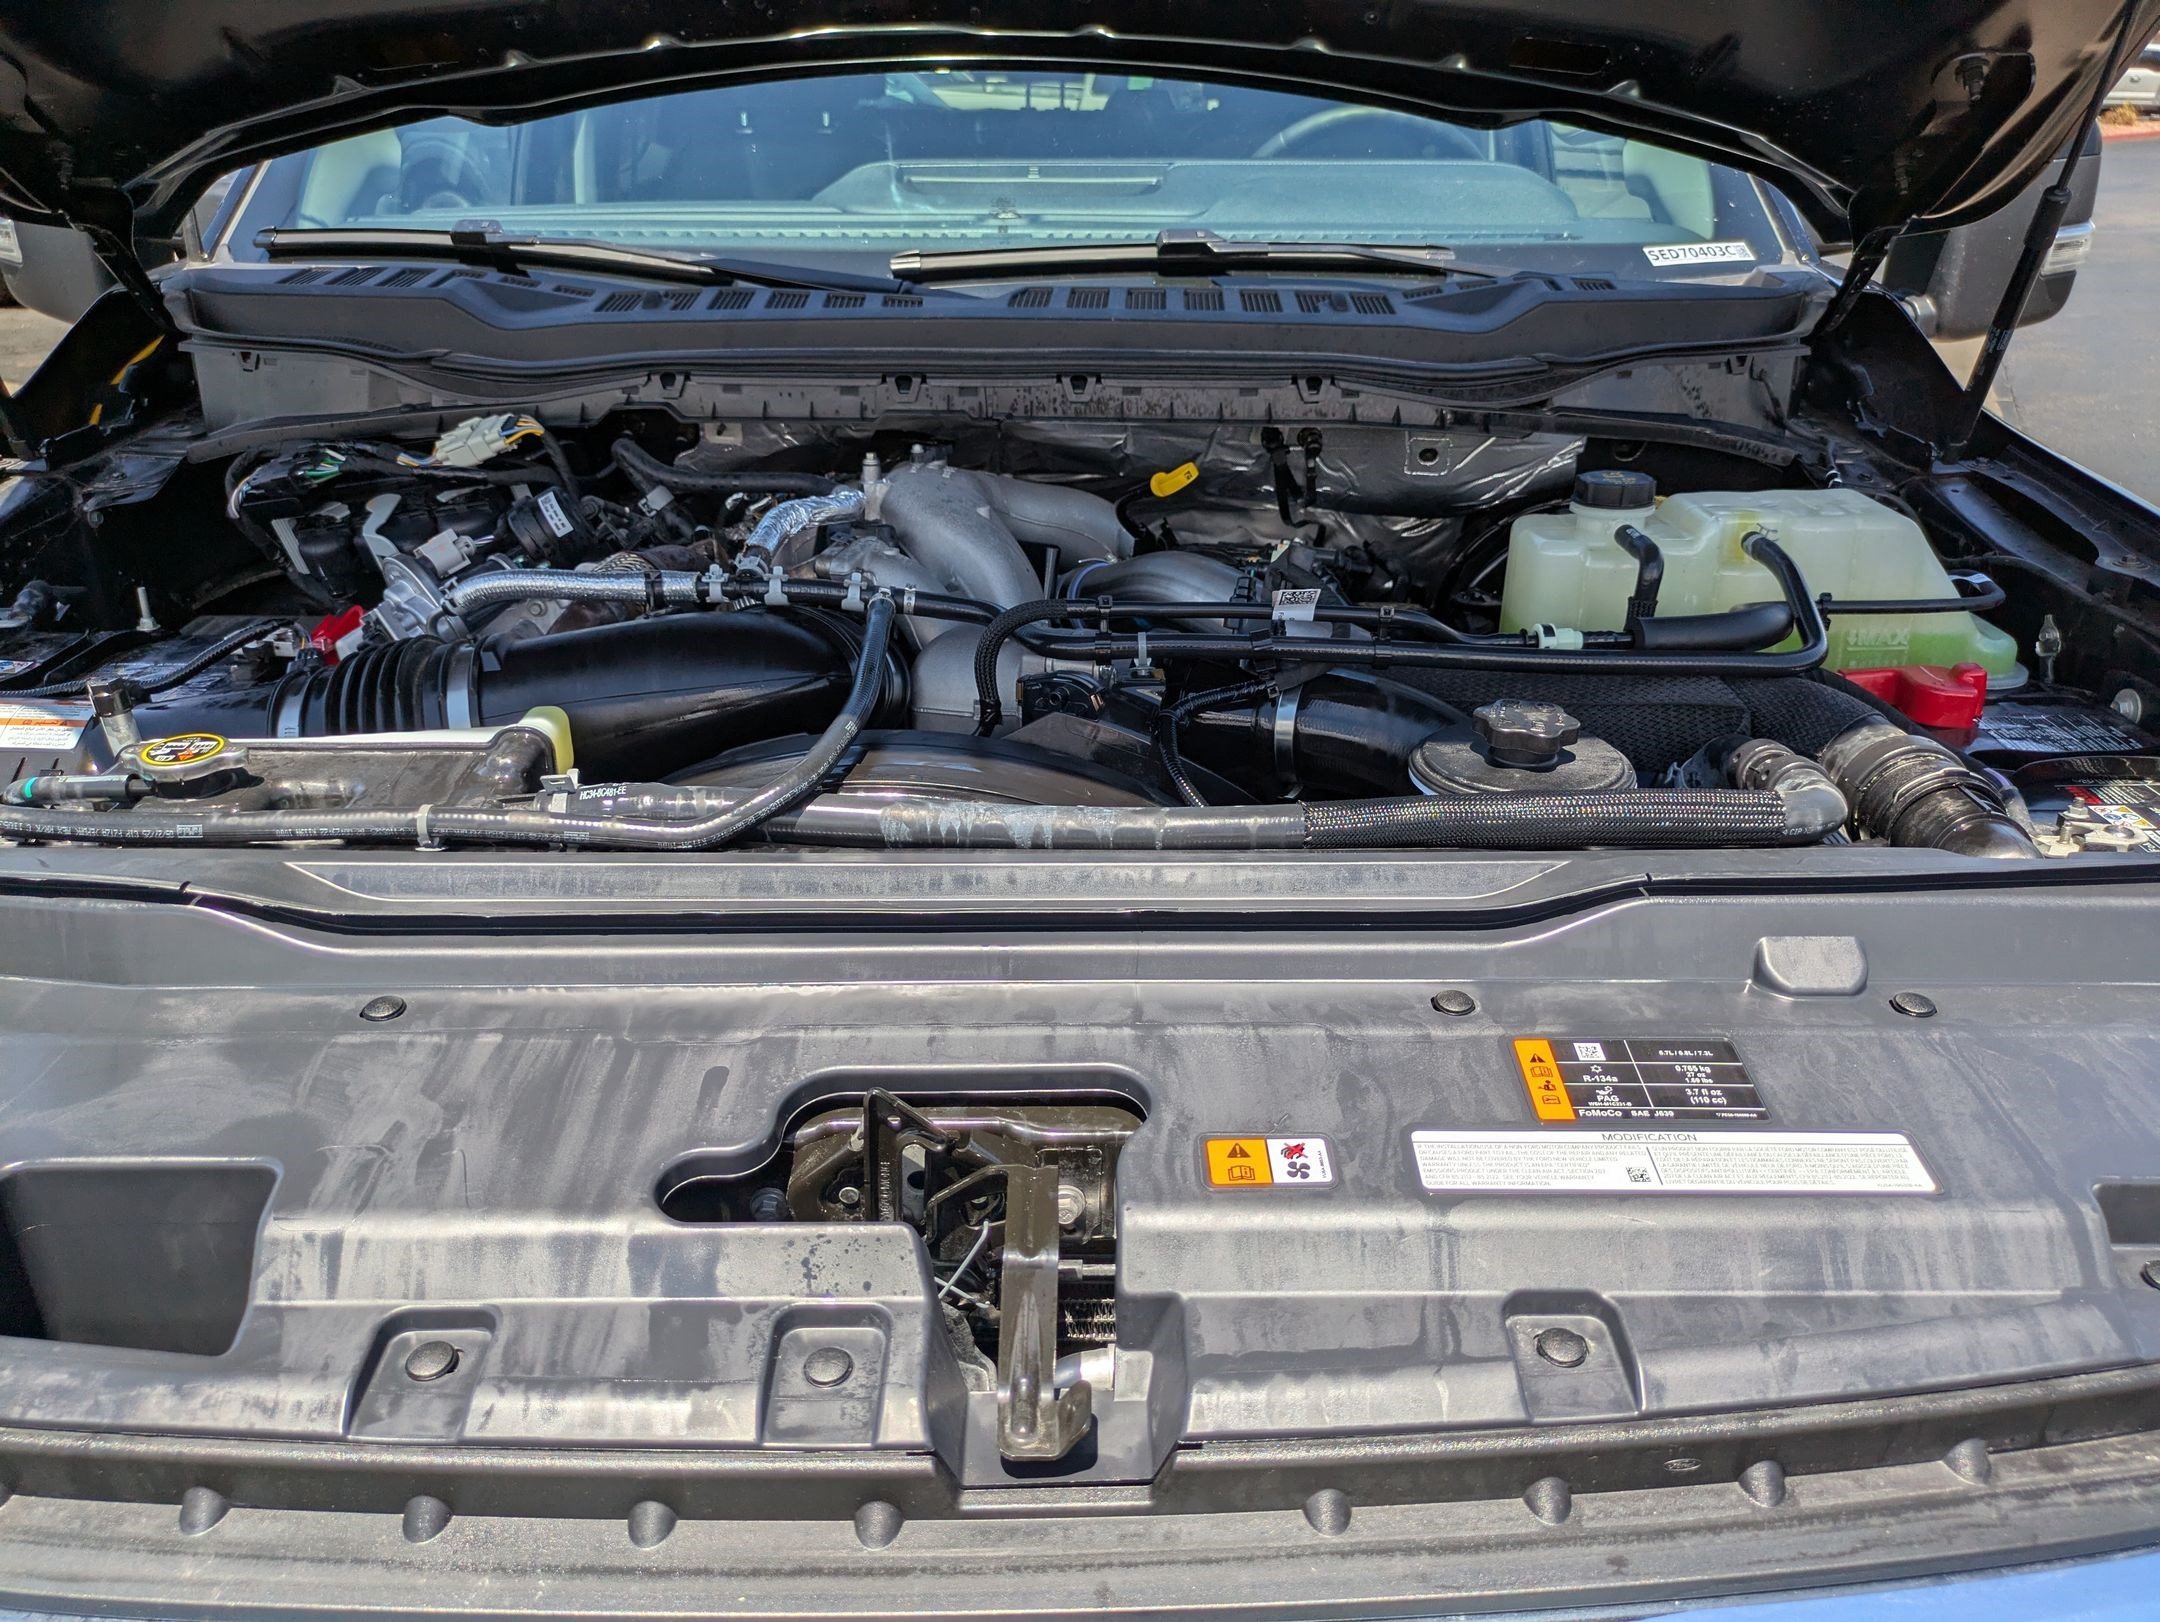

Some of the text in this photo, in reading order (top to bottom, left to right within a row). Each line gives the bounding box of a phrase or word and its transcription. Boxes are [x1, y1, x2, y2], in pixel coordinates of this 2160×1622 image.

[1648, 246, 1736, 261] SED70403C
[1699, 1065, 1711, 1073] kg
[1582, 1075, 1618, 1083] R-134a
[1685, 1088, 1699, 1096] 3.7
[1578, 1109, 1622, 1117] FoMoCo
[1601, 1133, 1697, 1141] MODIFICATION
